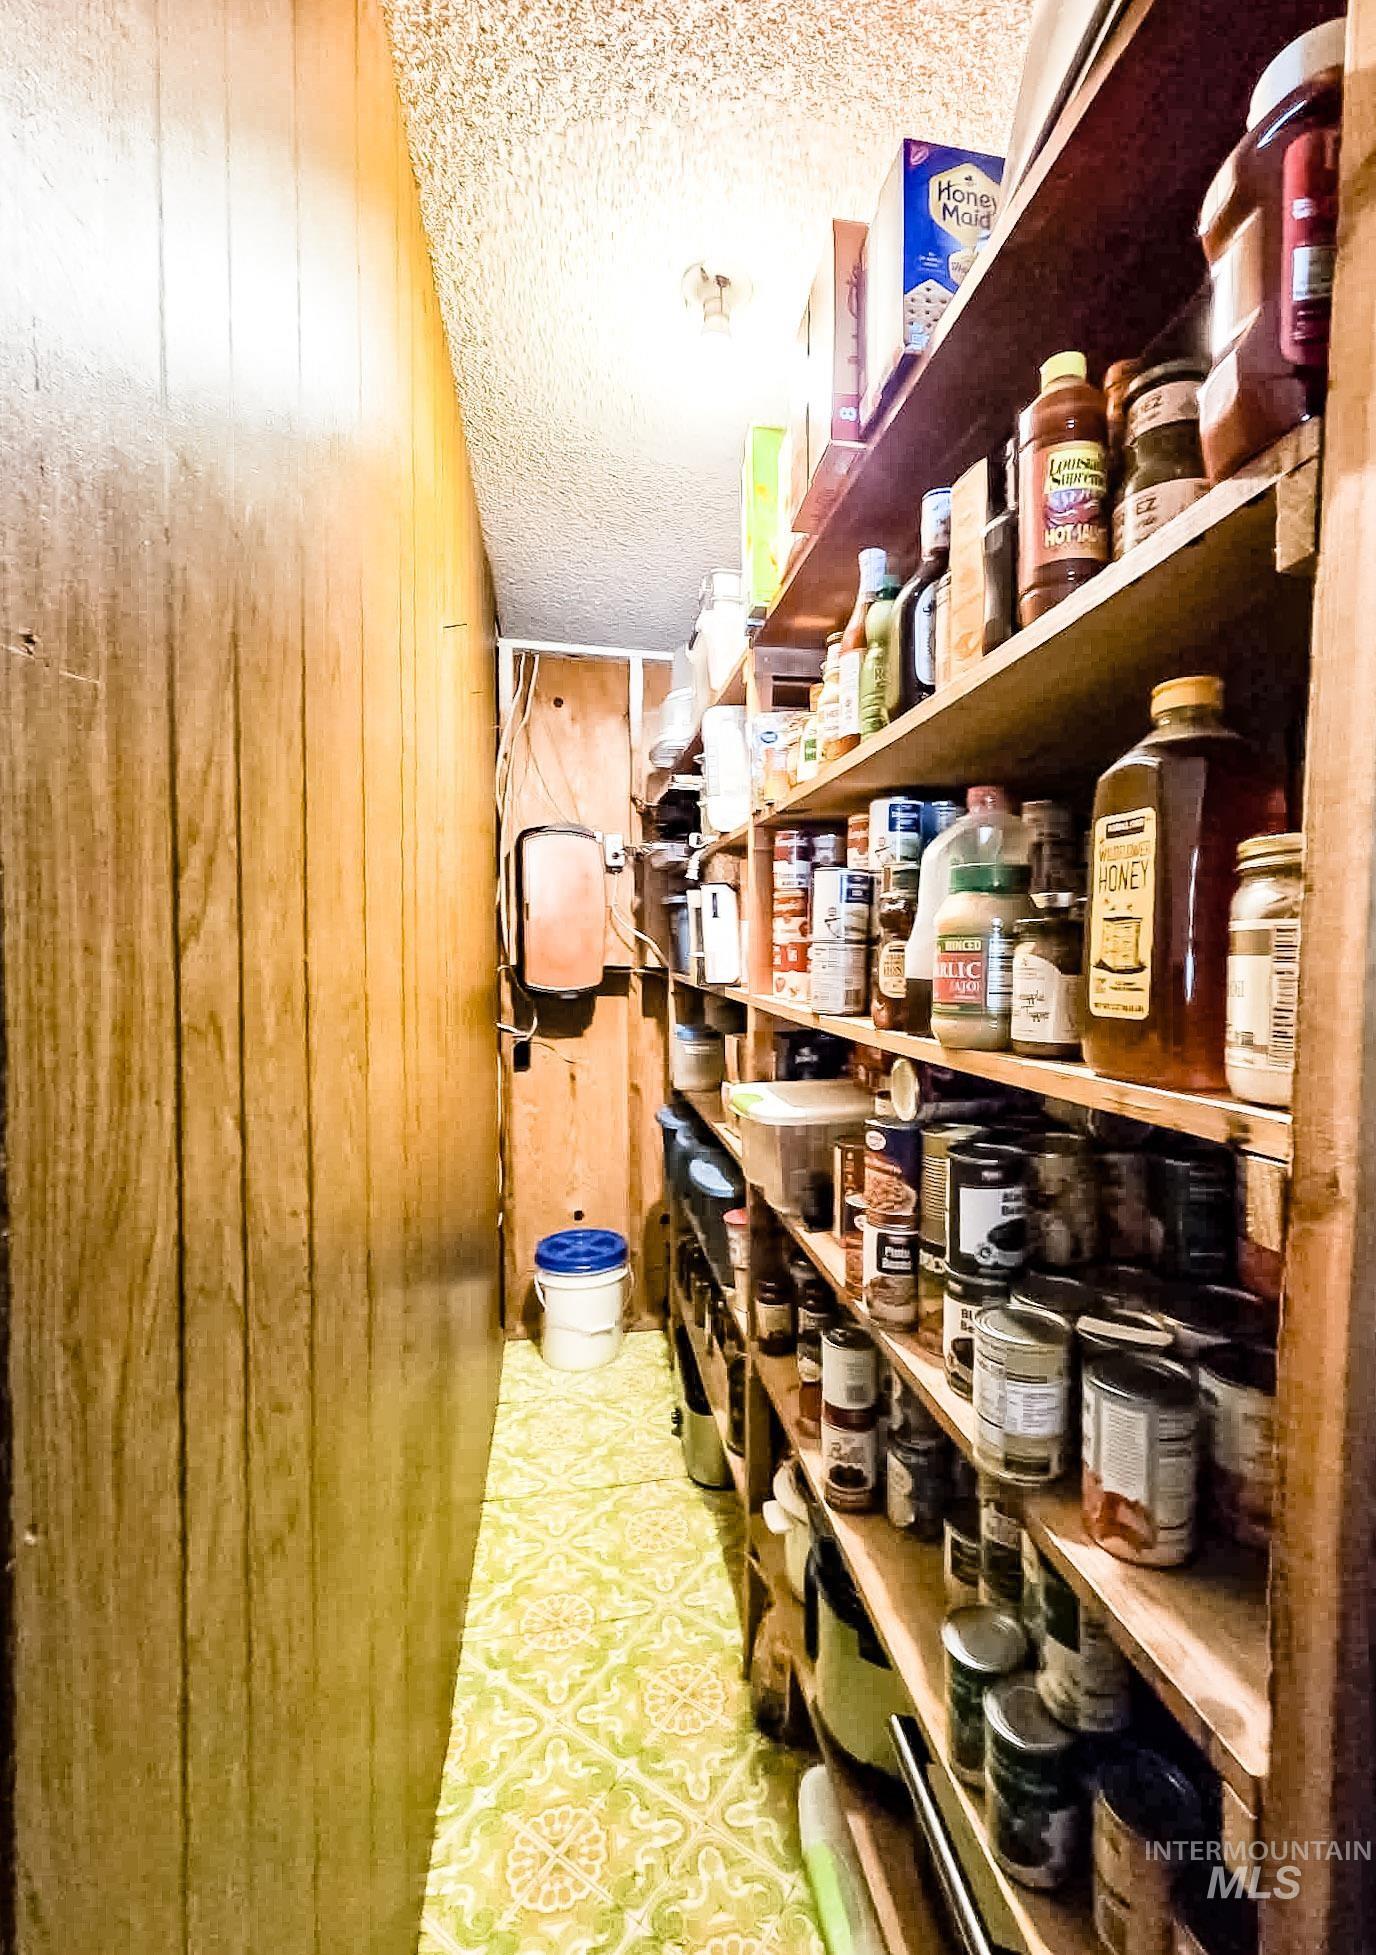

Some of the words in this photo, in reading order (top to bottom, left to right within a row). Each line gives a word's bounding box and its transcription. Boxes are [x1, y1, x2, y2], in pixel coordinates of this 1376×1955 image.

[937, 181, 997, 215] Honey
[942, 202, 991, 229] Maid
[1045, 524, 1075, 548] HOT
[1099, 858, 1149, 893] HONEY
